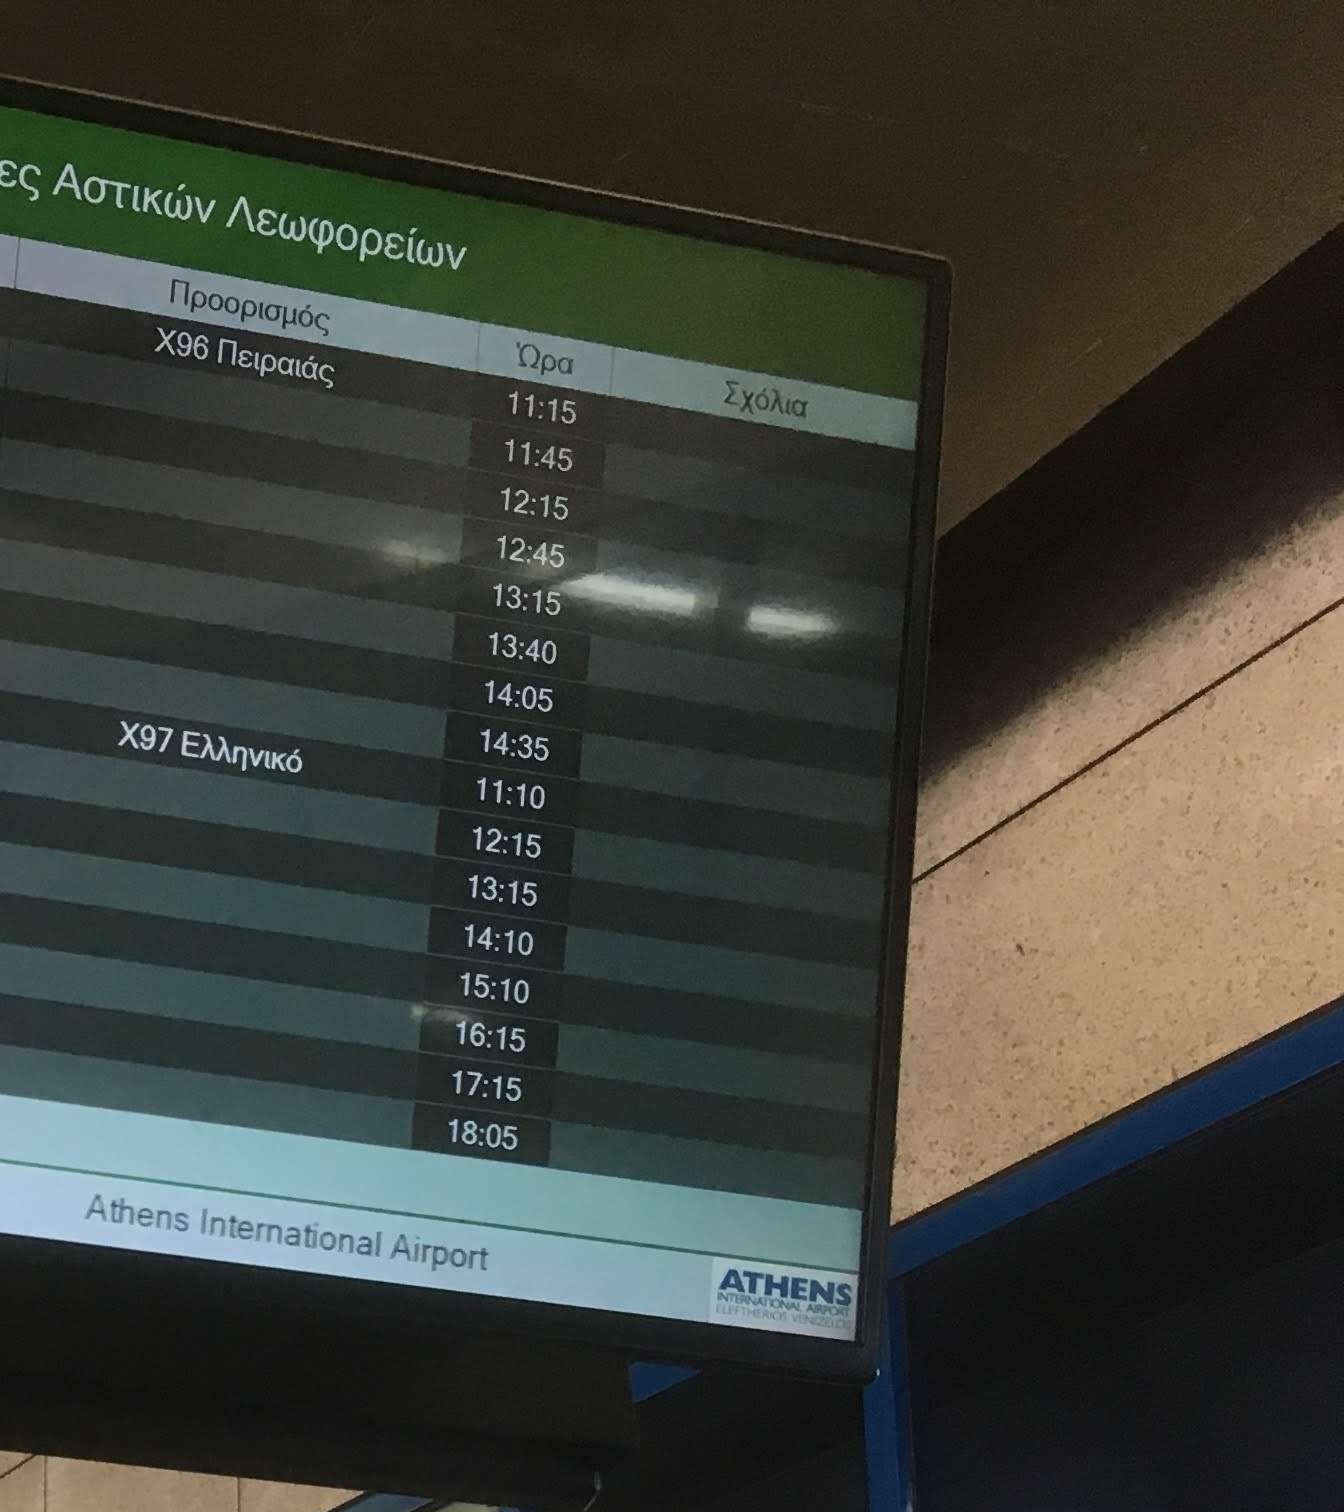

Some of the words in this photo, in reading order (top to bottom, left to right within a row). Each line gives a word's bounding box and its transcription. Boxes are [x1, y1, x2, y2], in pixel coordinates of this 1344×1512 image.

[52, 163, 217, 225] Αστικών
[226, 197, 468, 272] Λεωφορείων
[169, 278, 332, 337] Προορισμός
[216, 339, 336, 388] Πειραιάς
[516, 339, 575, 376] Ώρα
[508, 391, 578, 426] 11:15
[724, 380, 809, 418] Σχόλια
[504, 439, 574, 473] 11:45
[500, 487, 569, 521] 12:15
[496, 535, 565, 569] 12:45
[492, 583, 562, 617] 13:15
[488, 632, 558, 666] 13:40
[484, 680, 554, 714] 14:05
[181, 730, 303, 773] Ελληνικό
[480, 729, 550, 762] 14:35
[475, 776, 546, 811] 11:10
[471, 825, 542, 860] 12:15
[467, 874, 538, 909] 13:15
[463, 922, 534, 957] 14:10
[459, 971, 530, 1006] 15:10
[454, 1020, 526, 1054] 16:15
[450, 1068, 522, 1103] 17:15
[446, 1117, 519, 1152] 18:05
[84, 1193, 190, 1235] Athens
[200, 1209, 382, 1258] International
[389, 1234, 490, 1275] Airport
[716, 1292, 801, 1313] INTERNATIONAL
[806, 1303, 850, 1318] AIRPORT
[718, 1268, 853, 1307] ATHENS
